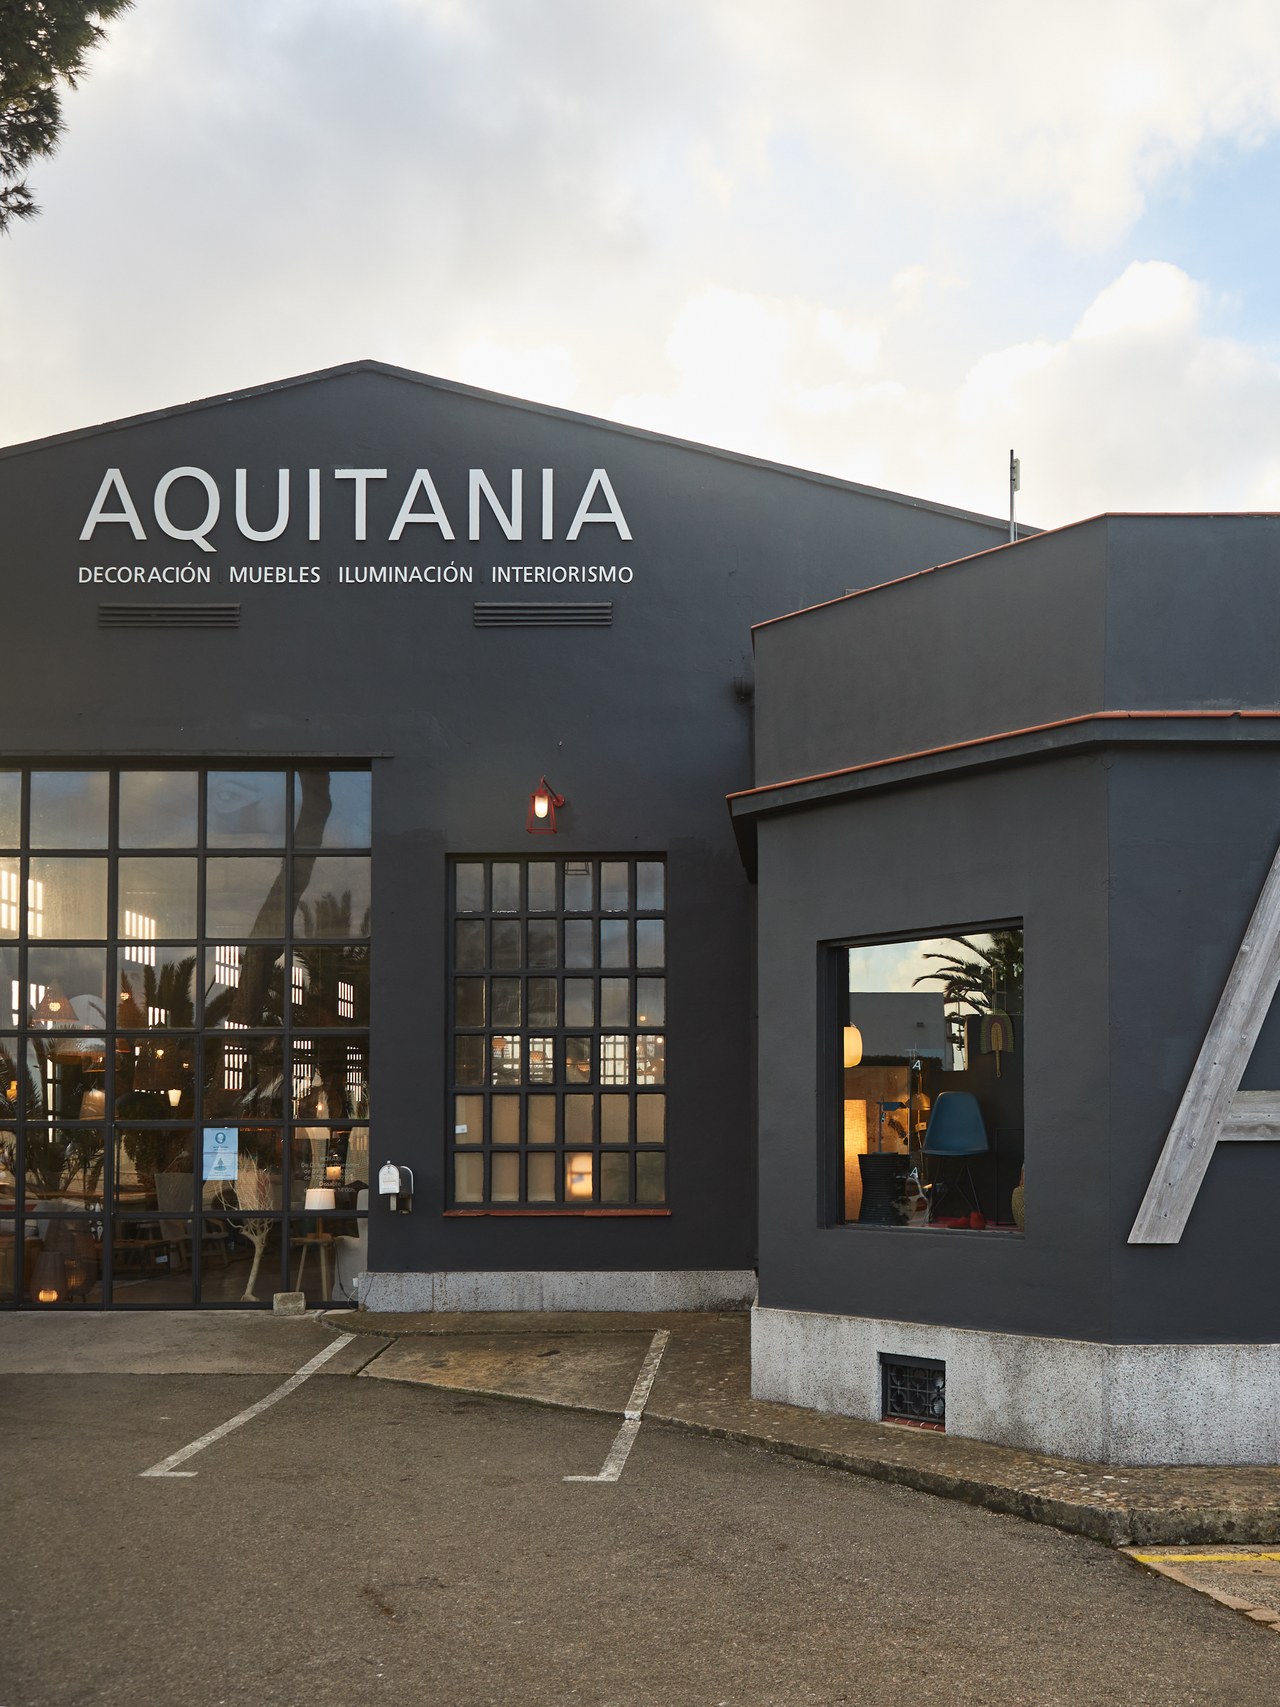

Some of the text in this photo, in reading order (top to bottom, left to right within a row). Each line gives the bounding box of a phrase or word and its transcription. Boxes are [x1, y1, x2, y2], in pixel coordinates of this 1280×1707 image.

[79, 466, 633, 552] AQUITANIA
[79, 560, 634, 584] DECORACIÓN MUEBLES ILUMINACIÓN INTERIORISMO
